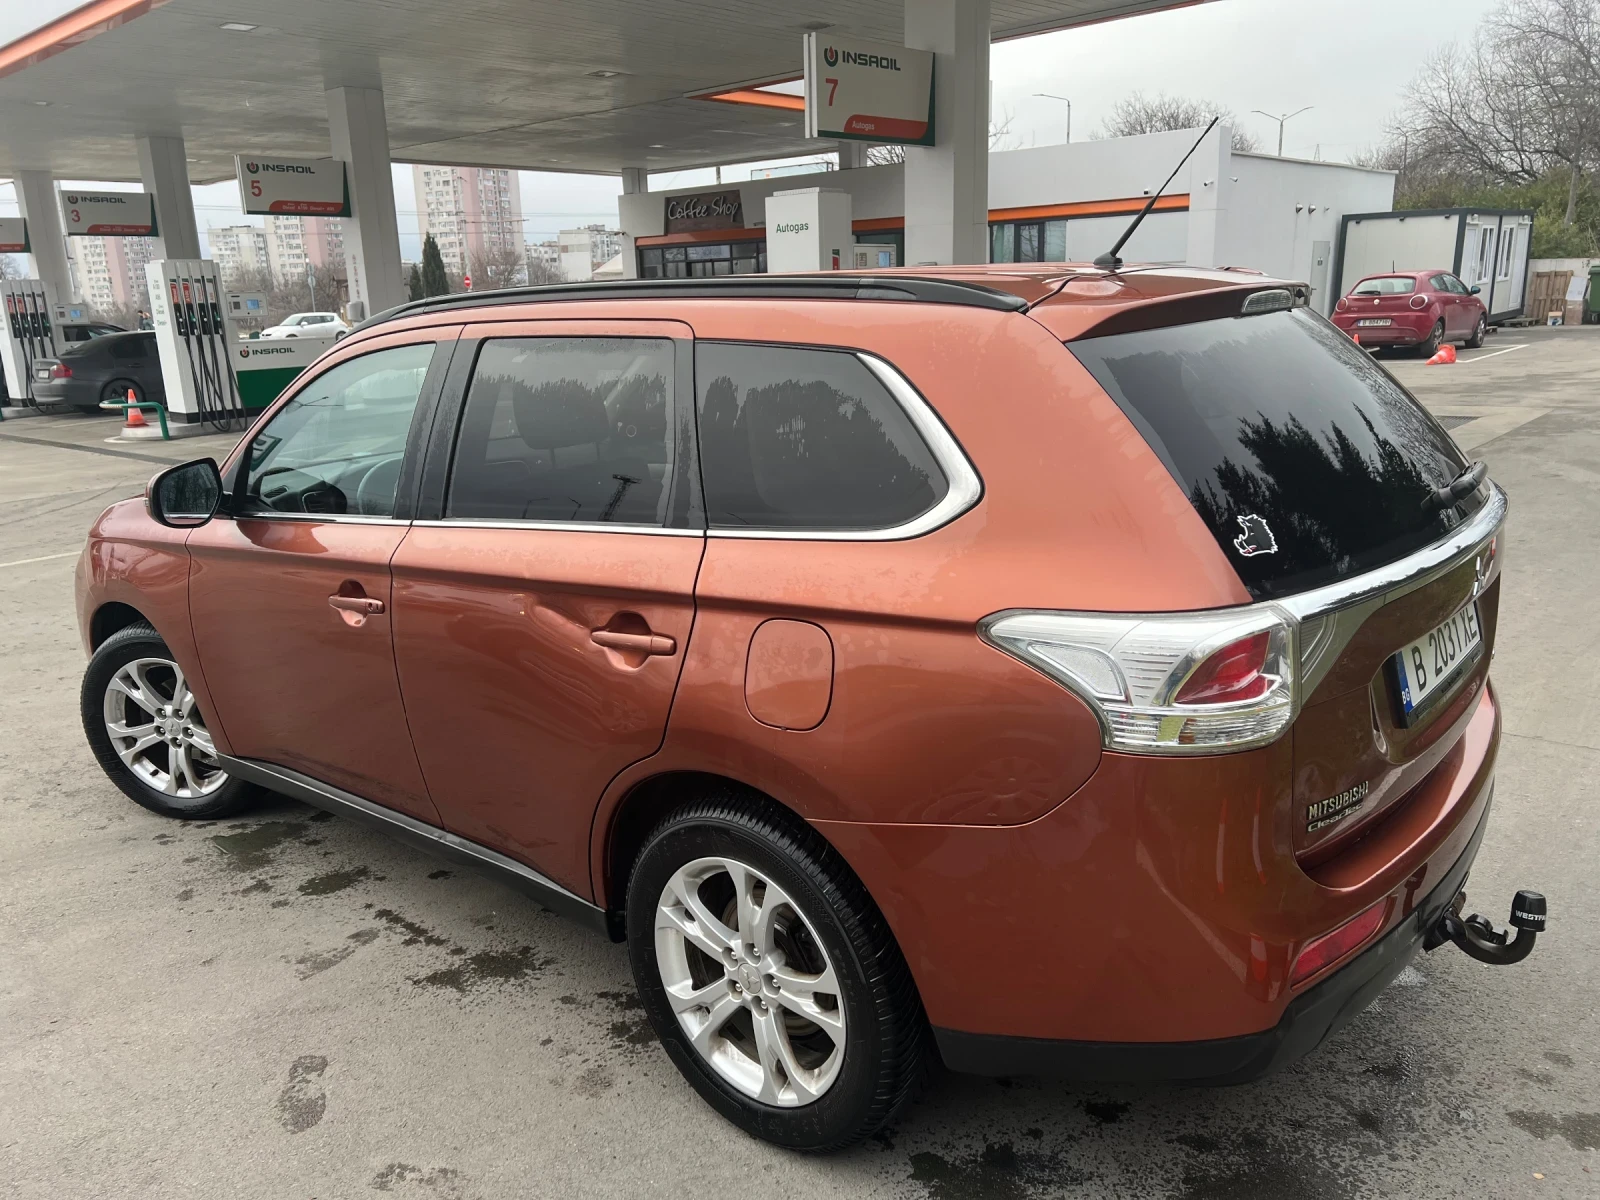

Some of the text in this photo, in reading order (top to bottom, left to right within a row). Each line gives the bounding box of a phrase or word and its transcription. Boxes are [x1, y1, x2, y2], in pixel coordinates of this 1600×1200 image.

[842, 50, 901, 71] INSAOIL
[825, 78, 839, 106] 7
[851, 120, 875, 131] Autogas
[262, 163, 316, 174] INSAOIL
[250, 180, 262, 197] 5
[80, 196, 126, 204] INSAOIL
[71, 209, 81, 222] 3
[667, 196, 739, 222] Coffee Shop
[776, 222, 809, 234] Autogas
[252, 347, 295, 355] INSAOIL
[1411, 646, 1427, 692] B
[1429, 617, 1462, 678] 2031
[1460, 607, 1477, 647] XE
[1402, 687, 1411, 704] BG
[1308, 780, 1369, 820] MITSUBISHI
